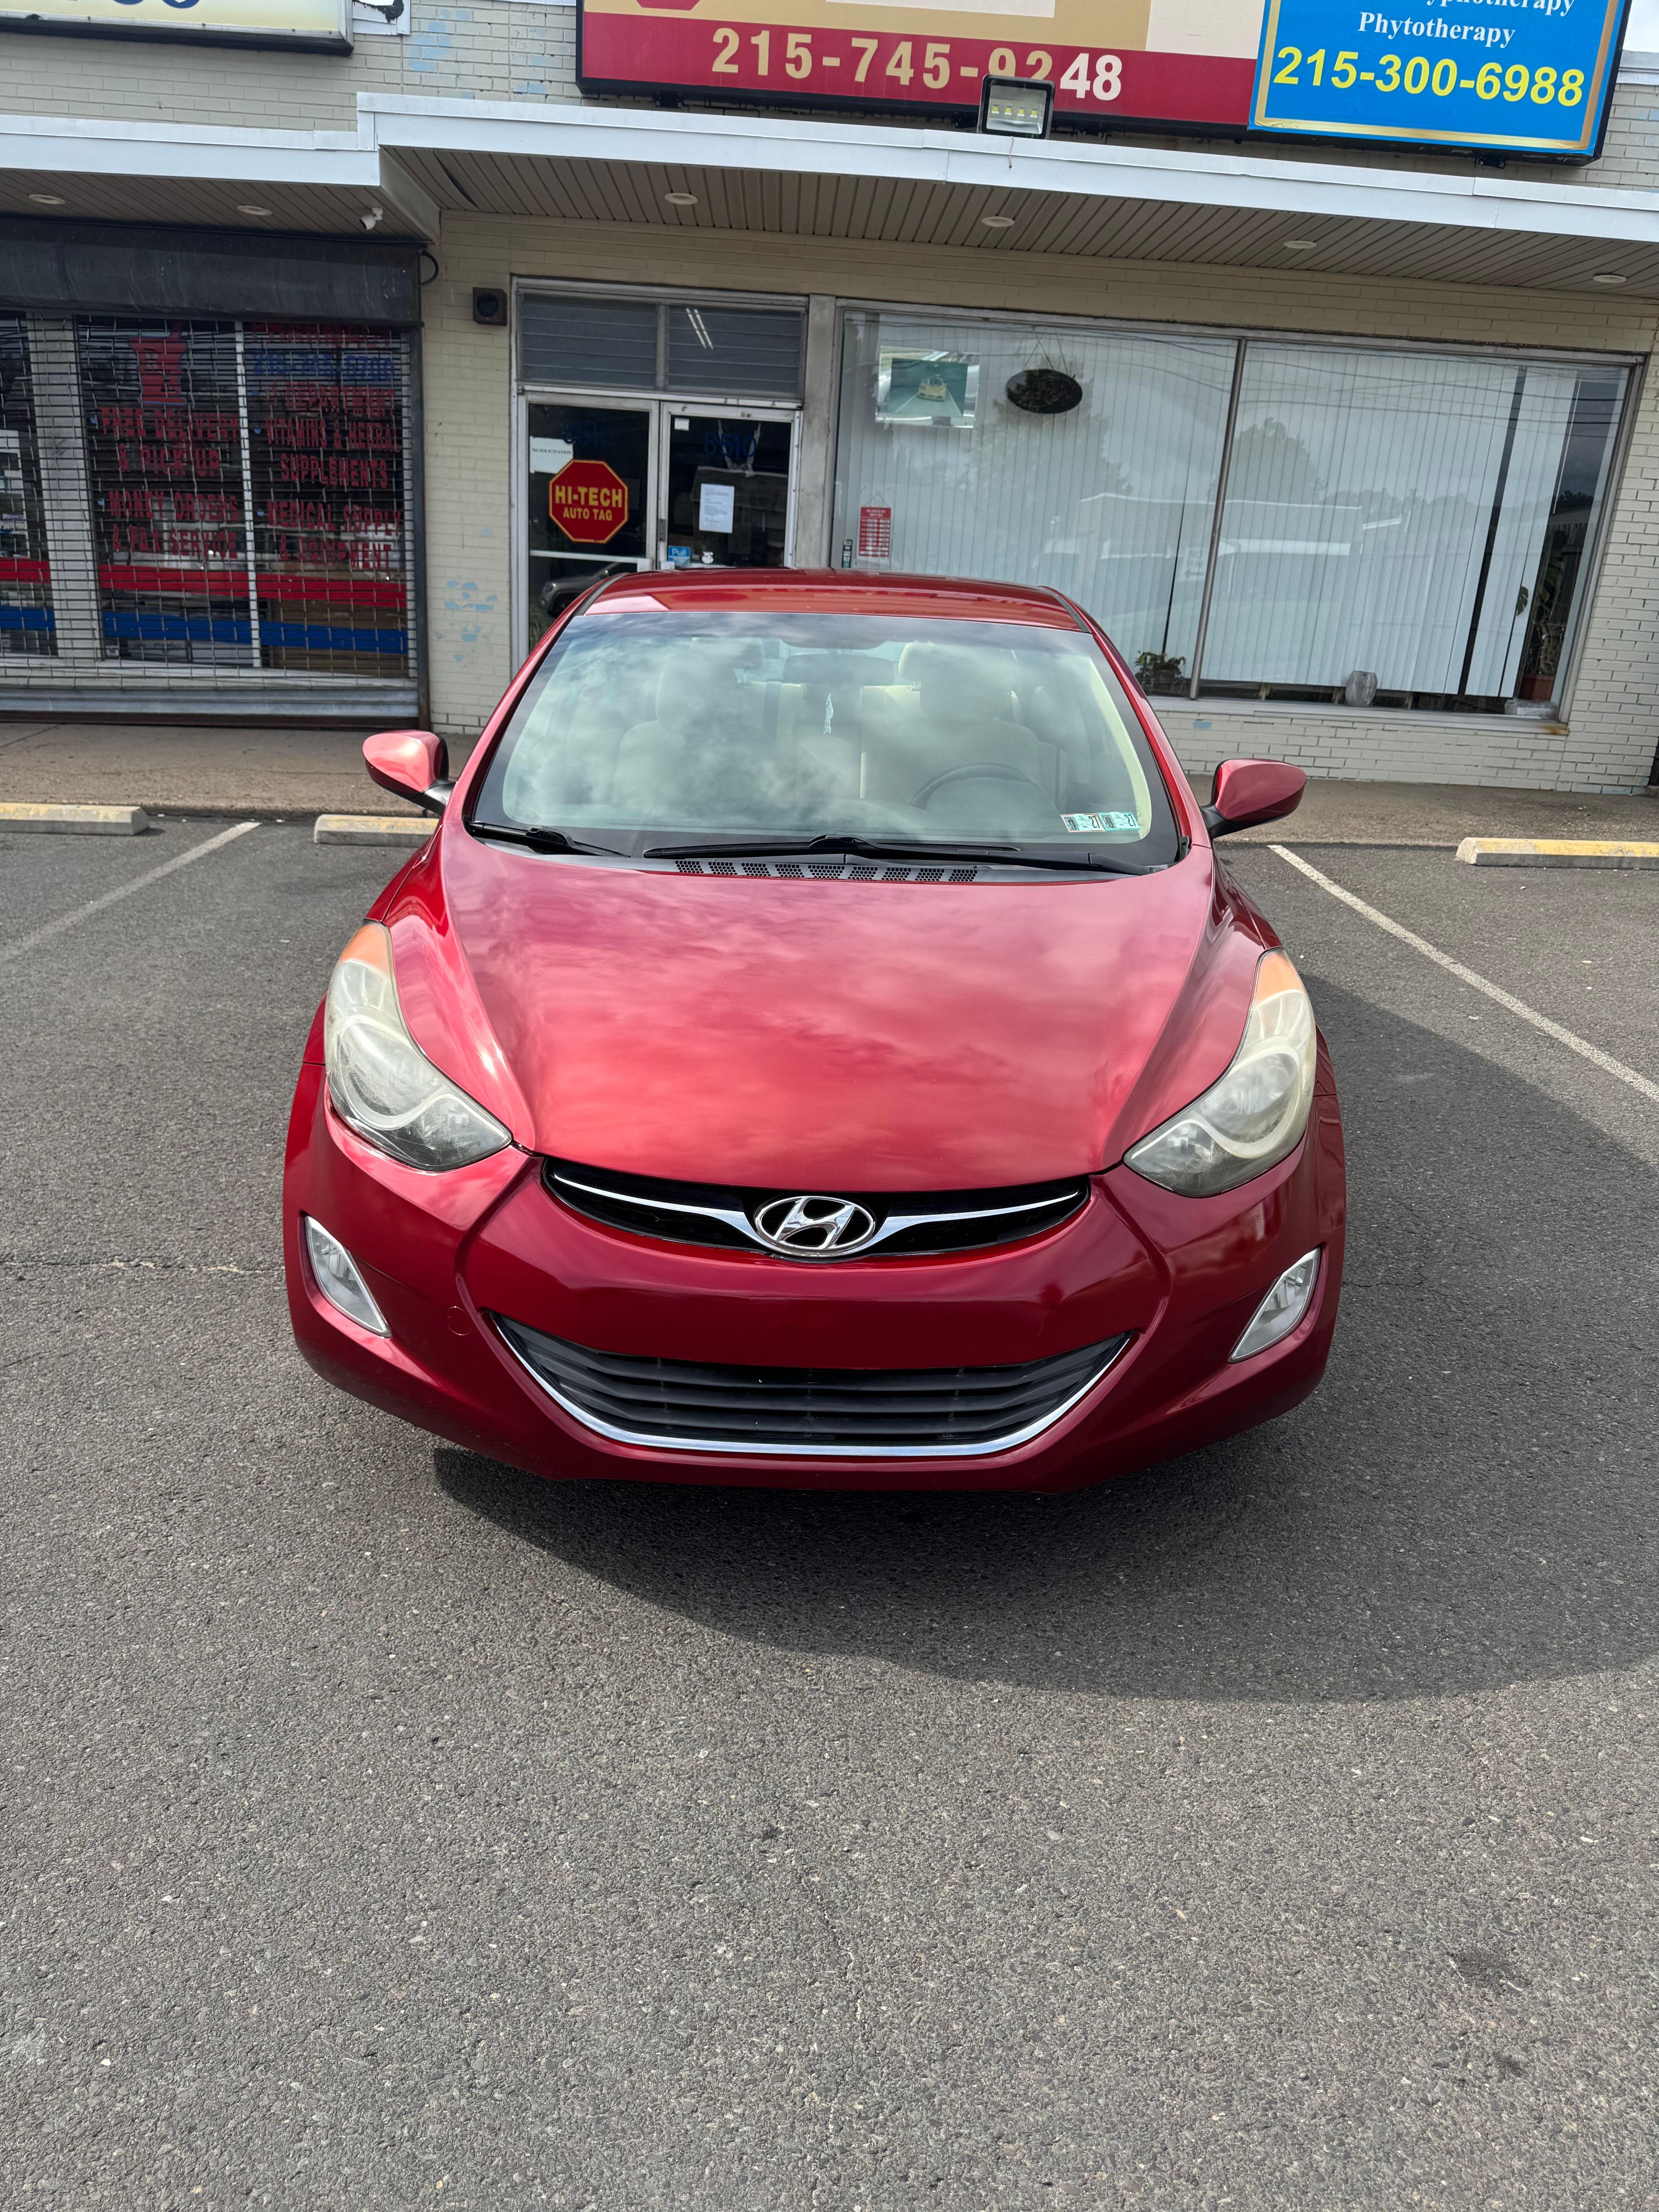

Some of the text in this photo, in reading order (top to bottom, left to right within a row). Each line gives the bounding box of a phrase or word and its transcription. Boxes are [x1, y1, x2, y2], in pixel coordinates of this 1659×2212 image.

[1357, 12, 1515, 48] Phytotherapy
[712, 27, 1122, 101] 215-745-9248
[1274, 46, 1585, 106] 215-300-6988
[101, 407, 238, 443] FREE DELIVERY
[265, 418, 327, 448] VITAMINS
[348, 421, 400, 452] HERBAL
[562, 421, 614, 447] 8510
[140, 446, 185, 476] PICK
[195, 449, 220, 477] UP
[704, 432, 757, 458] 8510
[280, 453, 388, 489] SUPPLEMENTS
[109, 491, 239, 522] MONEY ORDERS
[555, 485, 623, 508] HI-TECH
[268, 500, 401, 537] MEDICAL SUPPLY
[563, 508, 613, 521] AUTO TAG
[129, 524, 161, 553] FAX
[169, 528, 238, 559] SERVICE
[299, 537, 392, 570] EQUIPMENT
[1089, 816, 1100, 829] 27
[1124, 814, 1136, 827] 27
